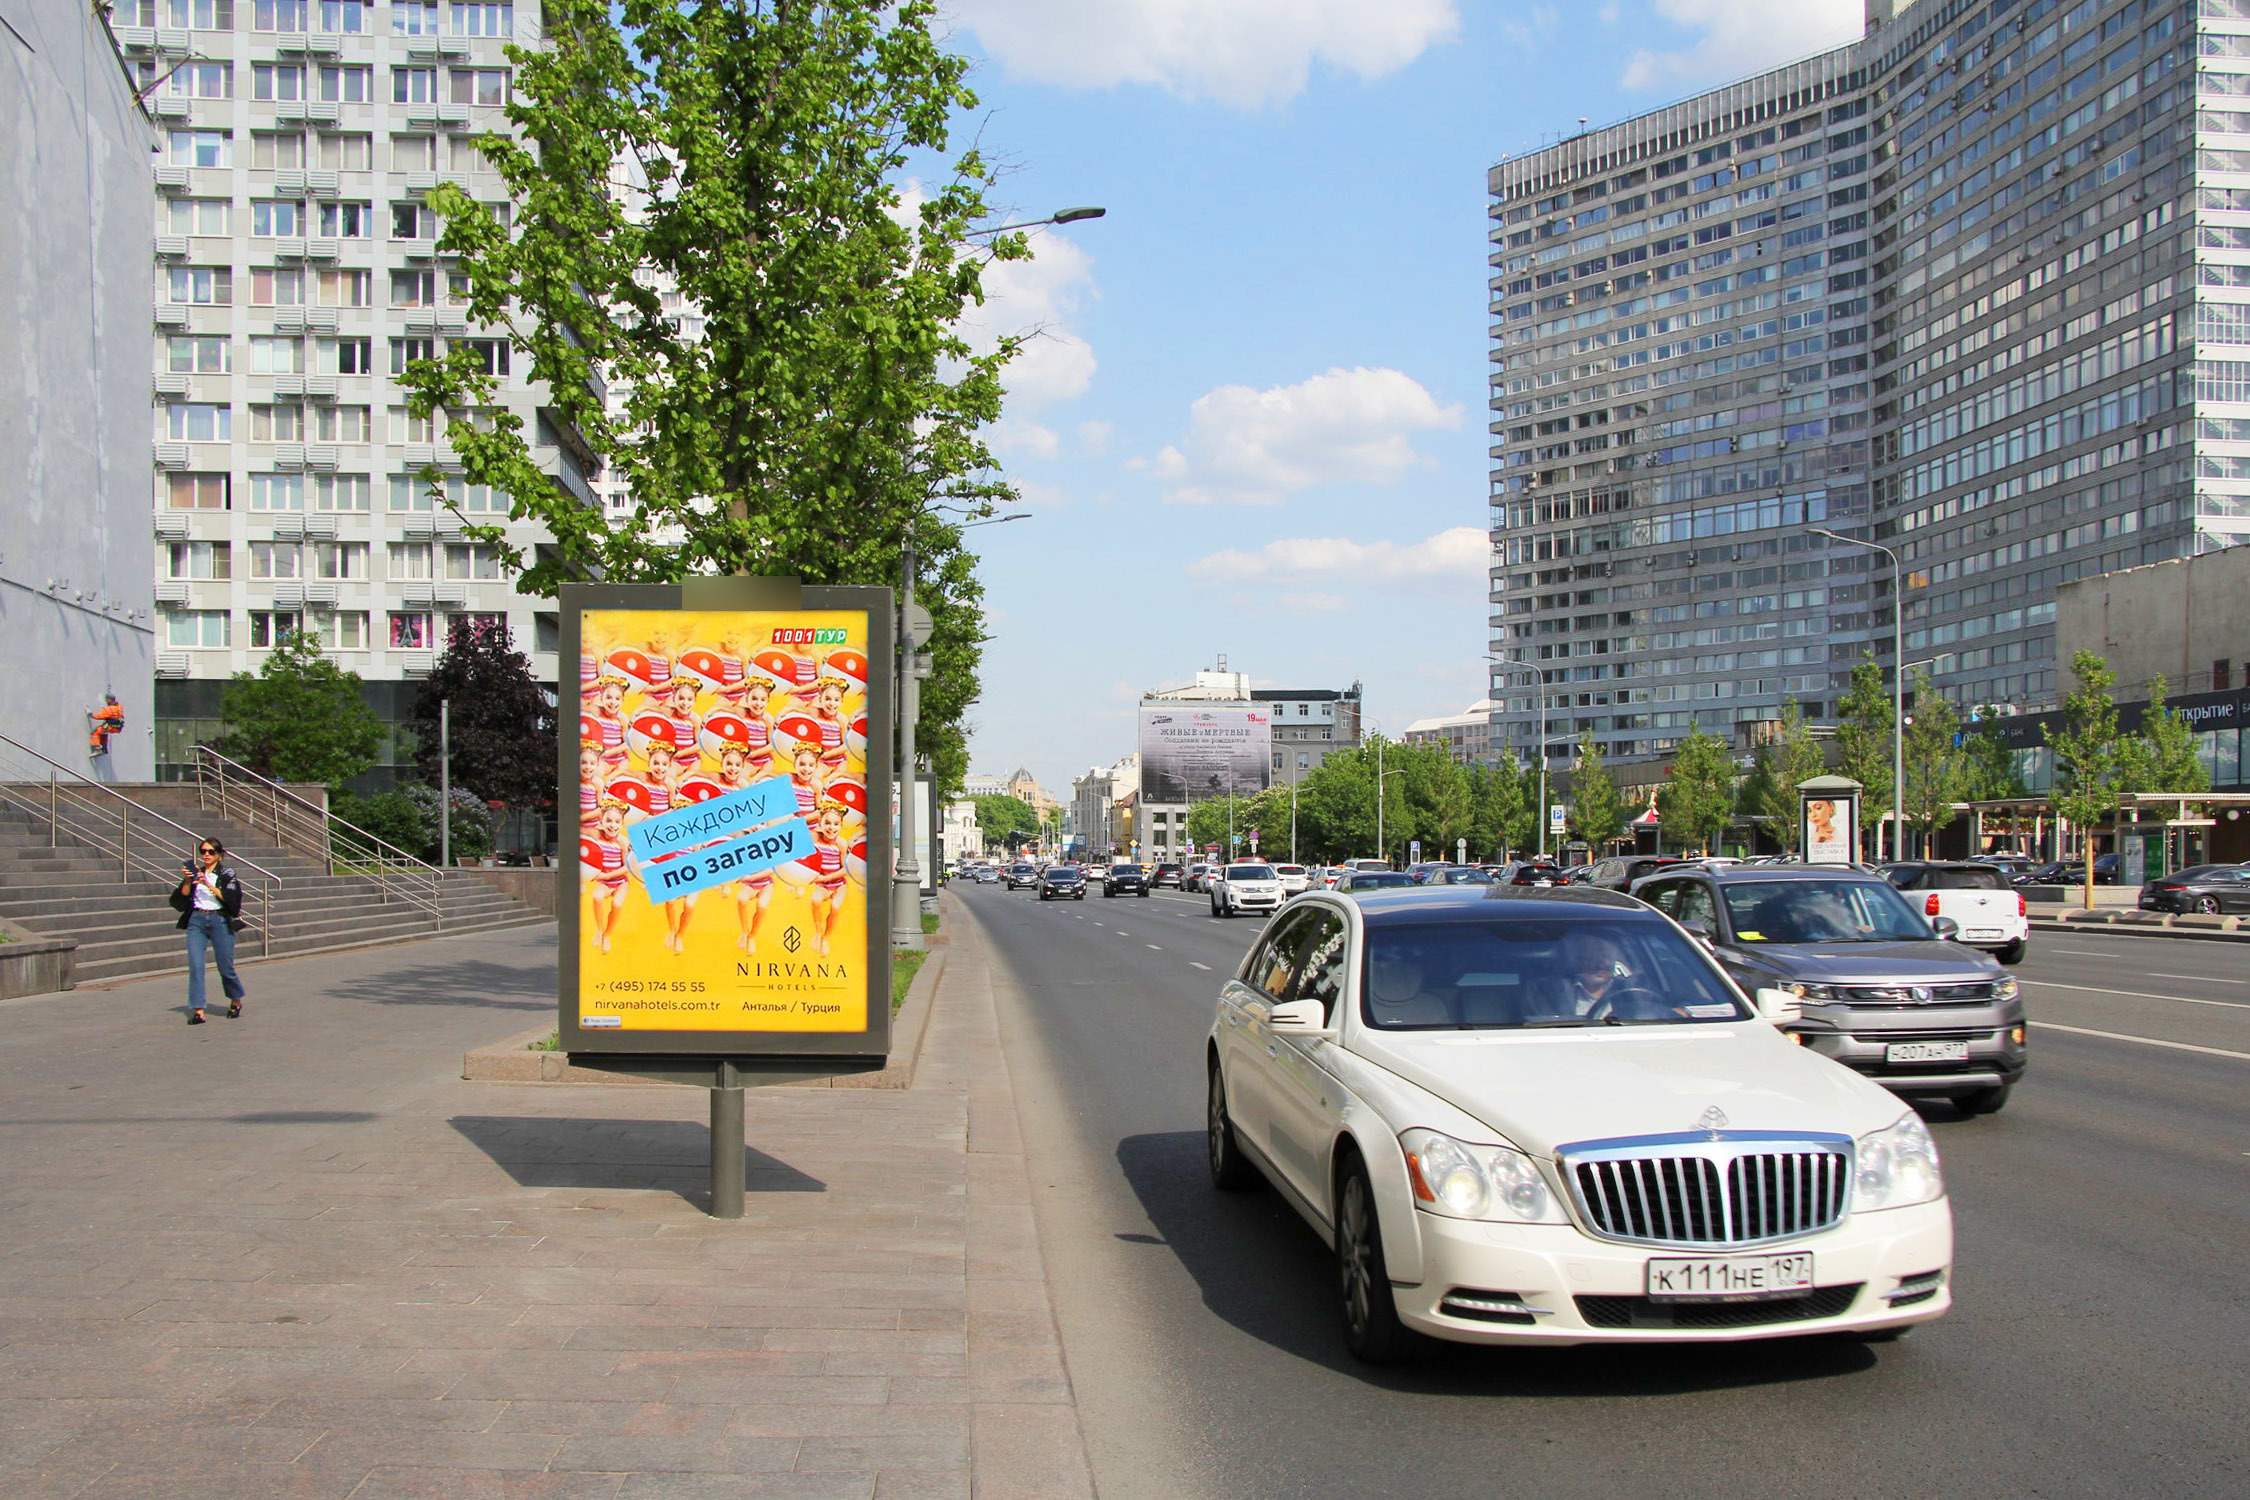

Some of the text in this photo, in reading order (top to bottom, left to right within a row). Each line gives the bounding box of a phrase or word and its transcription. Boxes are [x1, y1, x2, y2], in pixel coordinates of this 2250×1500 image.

[1247, 713, 1256, 722] 19
[644, 794, 766, 848] Каждому
[662, 831, 794, 888] по загару
[737, 962, 847, 978] NIRVANA
[609, 981, 644, 992] (495)
[648, 982, 667, 991] 174
[671, 982, 686, 992] 55
[690, 982, 705, 992] 55
[595, 999, 720, 1011] nirvanahotels.com.tr
[742, 1001, 787, 1012] Анталья
[801, 1002, 841, 1014] Турция
[1770, 1257, 1806, 1278] 197
